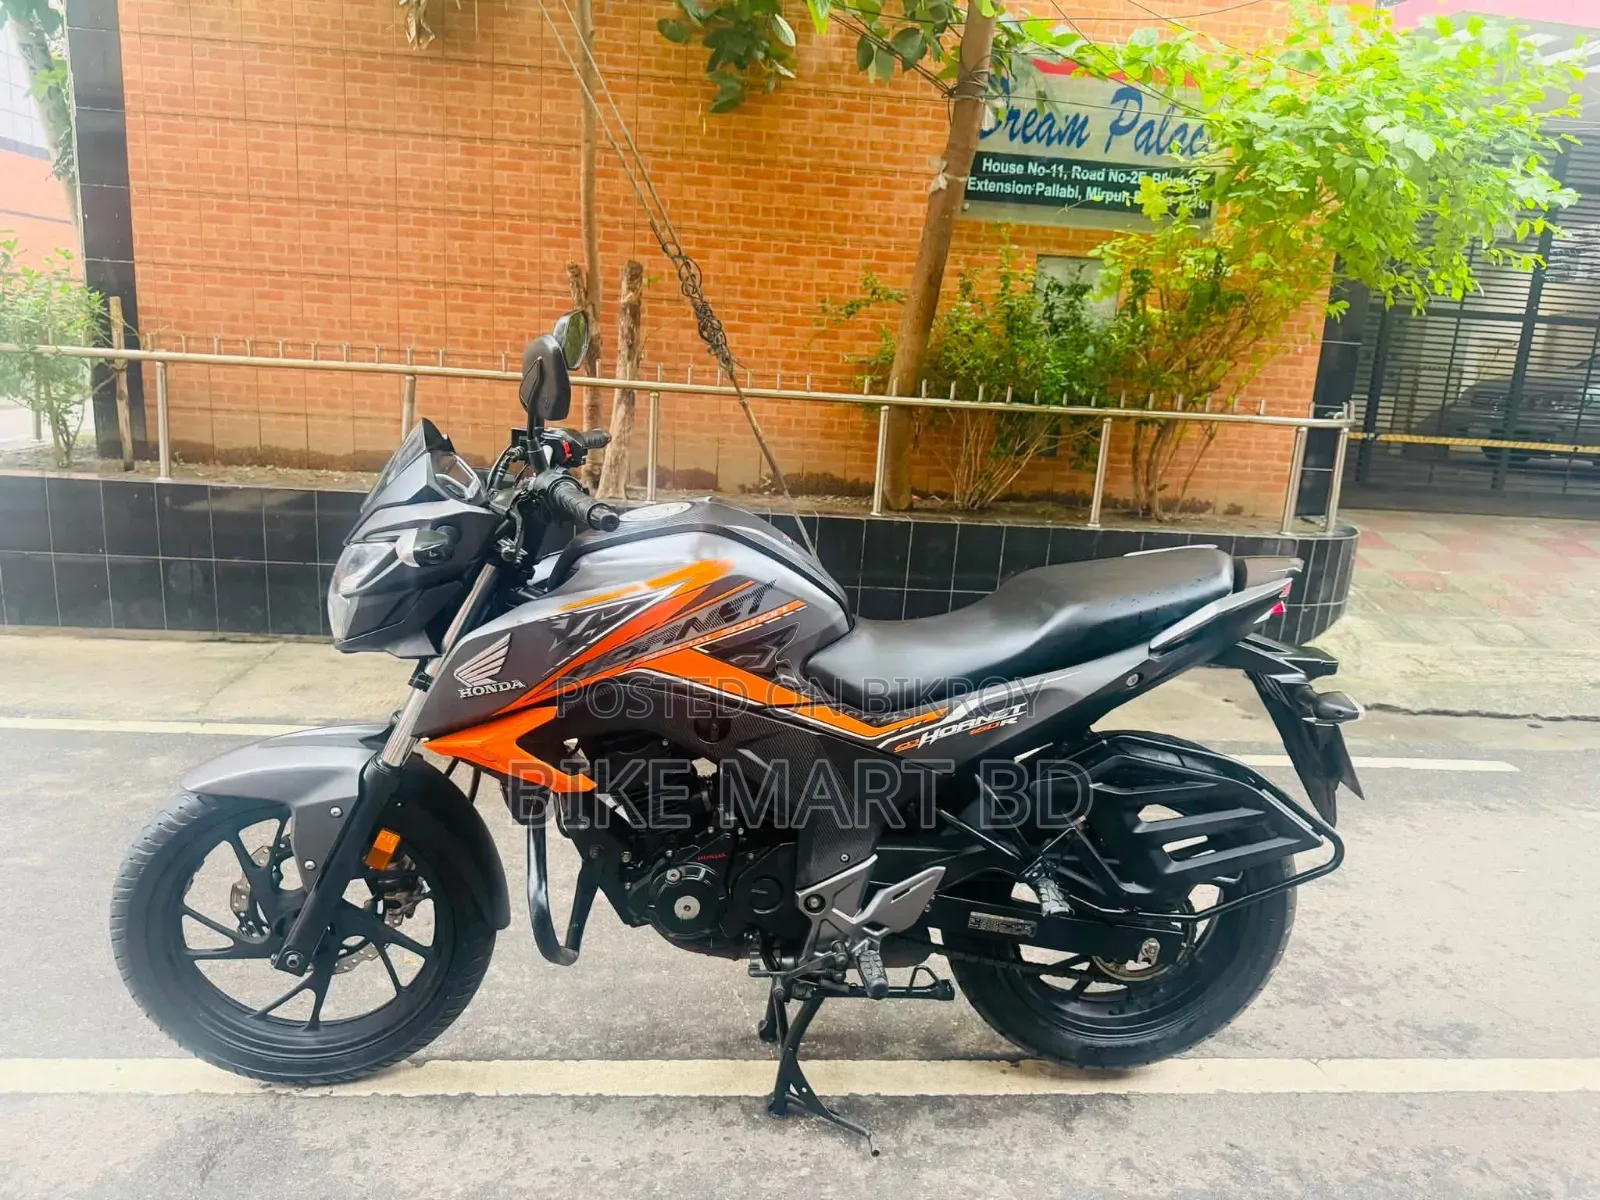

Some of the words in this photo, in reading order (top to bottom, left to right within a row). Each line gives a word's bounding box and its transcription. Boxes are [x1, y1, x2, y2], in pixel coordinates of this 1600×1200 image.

[1104, 86, 1213, 157] Palac
[982, 158, 1024, 174] House
[1027, 161, 1068, 180] No-11,
[1071, 165, 1105, 181] Road
[967, 177, 1032, 195] Extension
[1035, 182, 1082, 200] Pallabi,
[458, 679, 526, 698] HONDA
[917, 702, 1027, 749] HORNET
